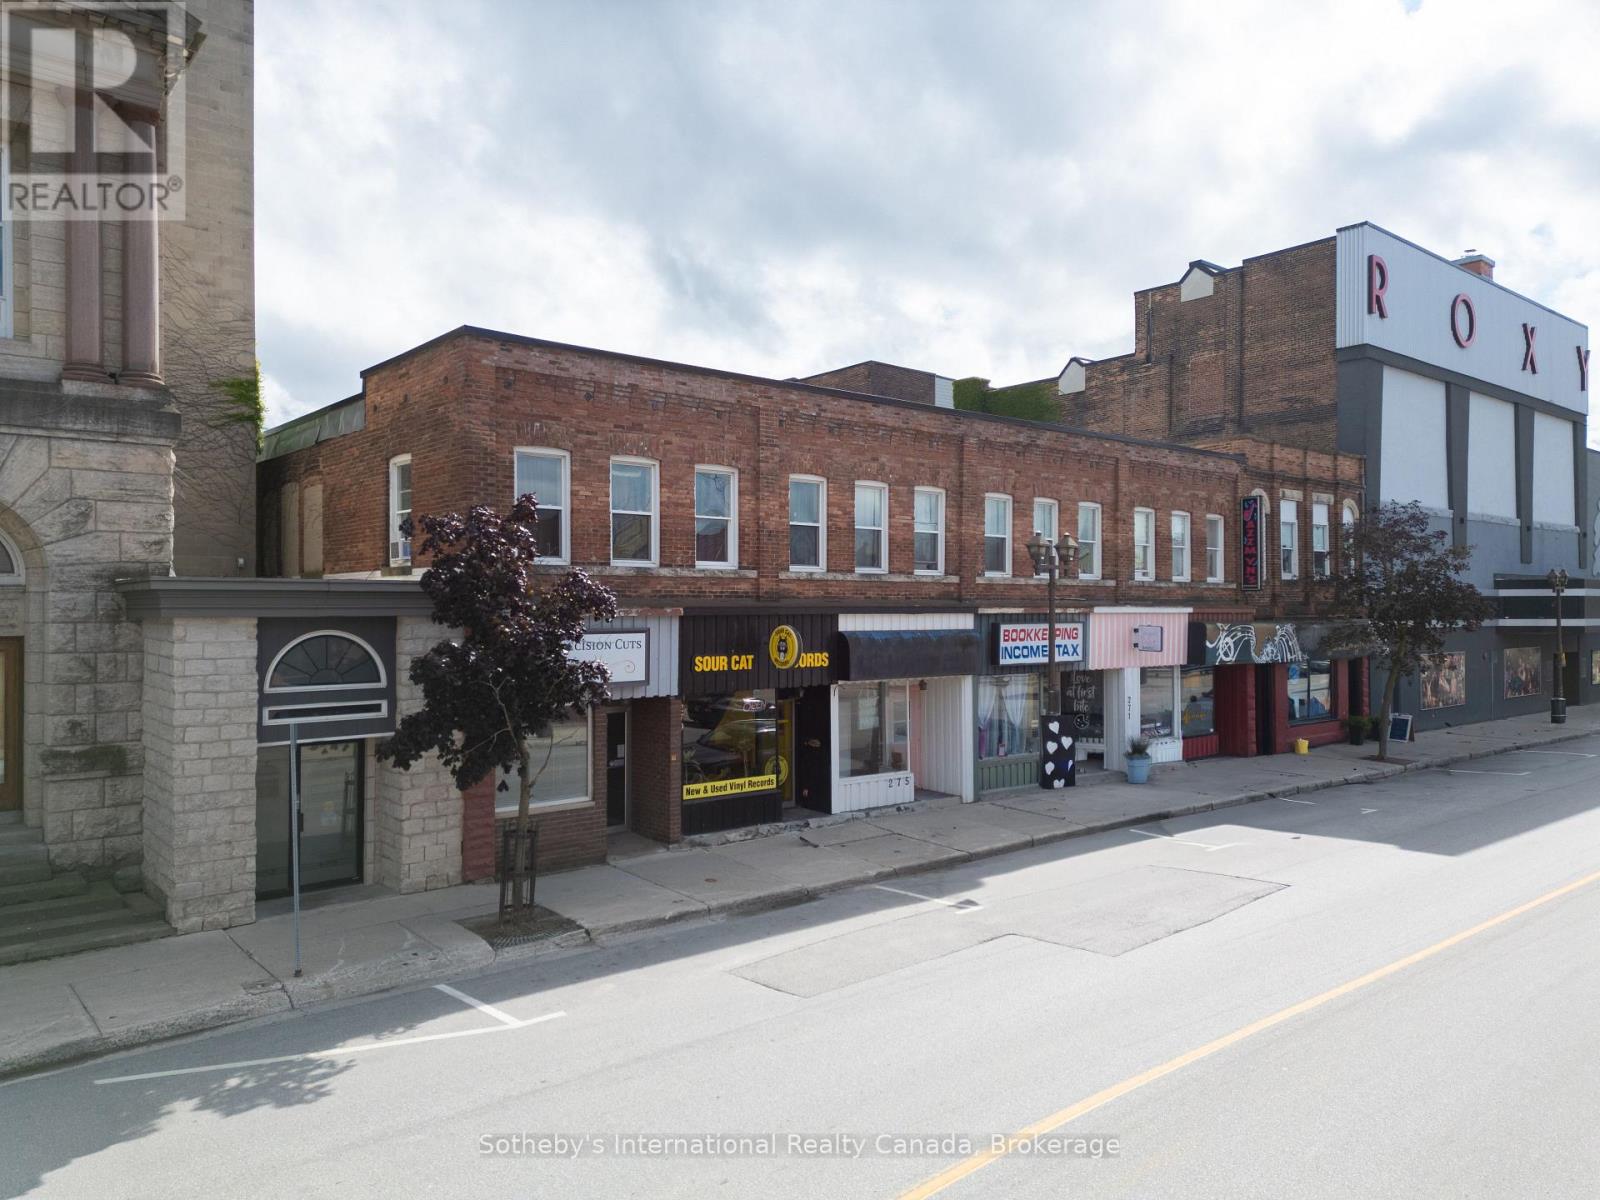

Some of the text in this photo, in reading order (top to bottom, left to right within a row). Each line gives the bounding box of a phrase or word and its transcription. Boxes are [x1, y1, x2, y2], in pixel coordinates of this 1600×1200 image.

[1368, 254, 1591, 392] ROXY
[1002, 627, 1079, 642] BOOKKEPING
[574, 638, 612, 651] CISION
[1001, 643, 1080, 660] INCOME TAX
[694, 655, 728, 672] SOUR
[731, 655, 754, 671] CAT
[796, 652, 829, 668] ORDS
[686, 777, 775, 796] New & Used Vinyl Records
[888, 776, 910, 788] 275
